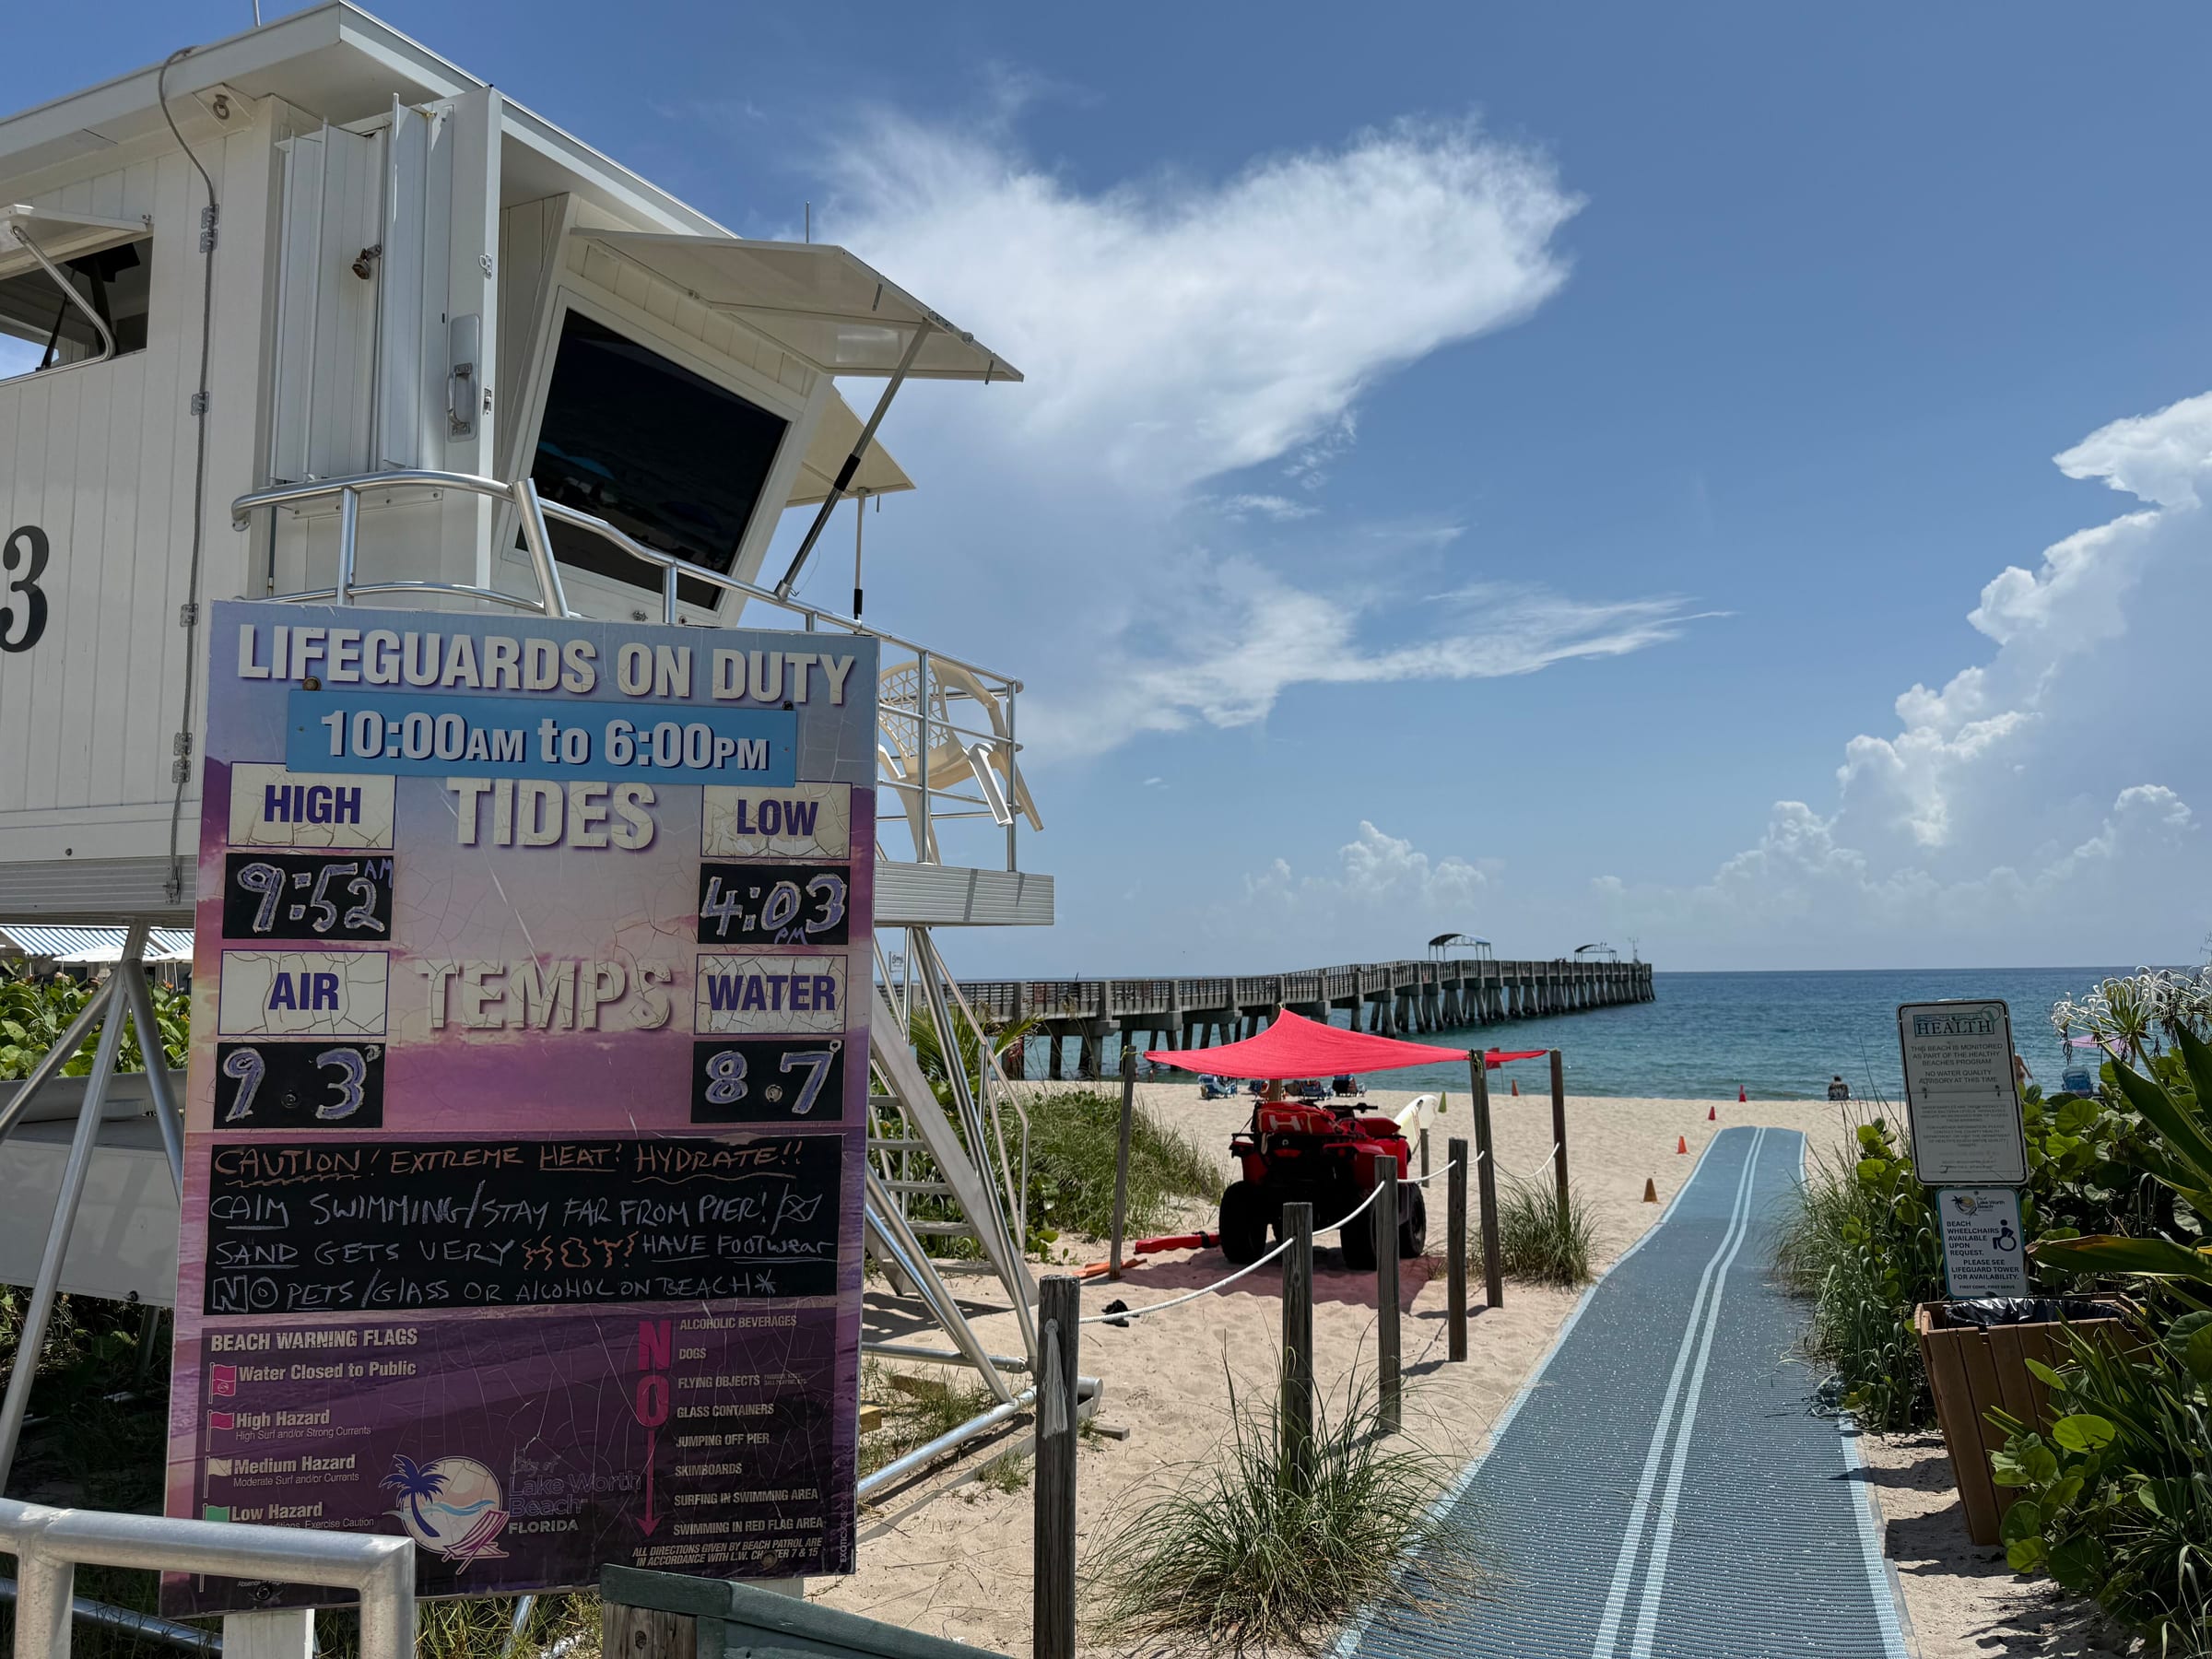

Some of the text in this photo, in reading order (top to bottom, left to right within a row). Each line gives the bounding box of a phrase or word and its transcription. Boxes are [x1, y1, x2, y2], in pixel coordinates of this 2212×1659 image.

[0, 525, 49, 653] 3
[237, 623, 855, 706] LIFEGUARDS ON DUTY
[322, 710, 771, 772] 10:00AM to 6:00PM
[264, 784, 361, 824] HIGH
[446, 779, 655, 851] TIDES
[737, 799, 818, 836] LOW
[237, 863, 385, 933] 9:52
[700, 874, 847, 936] 4:03
[773, 926, 808, 945] PM
[268, 972, 339, 1010] AIR
[418, 959, 671, 1030] TEMPS
[707, 974, 836, 1011] WATER
[1917, 1019, 1991, 1034] HEALTH
[391, 1147, 524, 1174] EXTREME
[540, 1143, 621, 1168] HEAT!
[636, 1141, 802, 1172] HYDRATE!!
[563, 1197, 612, 1227] FAR
[619, 1200, 689, 1227] FROM
[699, 1192, 767, 1224] PIER!
[216, 1241, 299, 1265] SAND
[314, 1241, 399, 1265] GETS
[419, 1240, 515, 1266] VERY
[644, 1233, 708, 1255] HAVE
[212, 1275, 278, 1313] NO
[465, 1281, 501, 1302] OR
[621, 1279, 651, 1298] ON
[679, 1315, 797, 1331] ALCOHOLIC BEVERAGES
[211, 1327, 418, 1352] BEACH WARNING FLAGS
[679, 1347, 706, 1360] DOGS
[239, 1360, 417, 1382] Water Closed to Public
[678, 1377, 712, 1389] FLYING
[716, 1374, 760, 1388] OBJECTS
[236, 1409, 330, 1431] High Hazard
[677, 1404, 774, 1418] GLASS CONTAINERS
[236, 1426, 371, 1442] High Surf and/or Strong Currents
[676, 1432, 770, 1448] JUMPING OFF PIER
[234, 1453, 356, 1475] Medium Hazard
[676, 1463, 742, 1477] SKIMBOARDS
[233, 1472, 359, 1488] Moderate Surf and/or Currents
[509, 1470, 641, 1496] Lake Worth
[509, 1494, 582, 1517] Beach
[674, 1488, 818, 1506] SURFING IN SWIMMING AREA
[232, 1501, 323, 1522] Low Hazard
[305, 1520, 340, 1529] Exercise
[343, 1517, 374, 1527] Caution
[509, 1519, 579, 1534] FLORIDA
[673, 1517, 823, 1536] SWIMMING IN RED FLAG AREA
[633, 1537, 823, 1558] ALL DIRECTIONS GIVEN BY BEACH PATROL ARE
[636, 1547, 818, 1567] IN ACCORDANCE WITH L.W. CHTER 7 & 15
